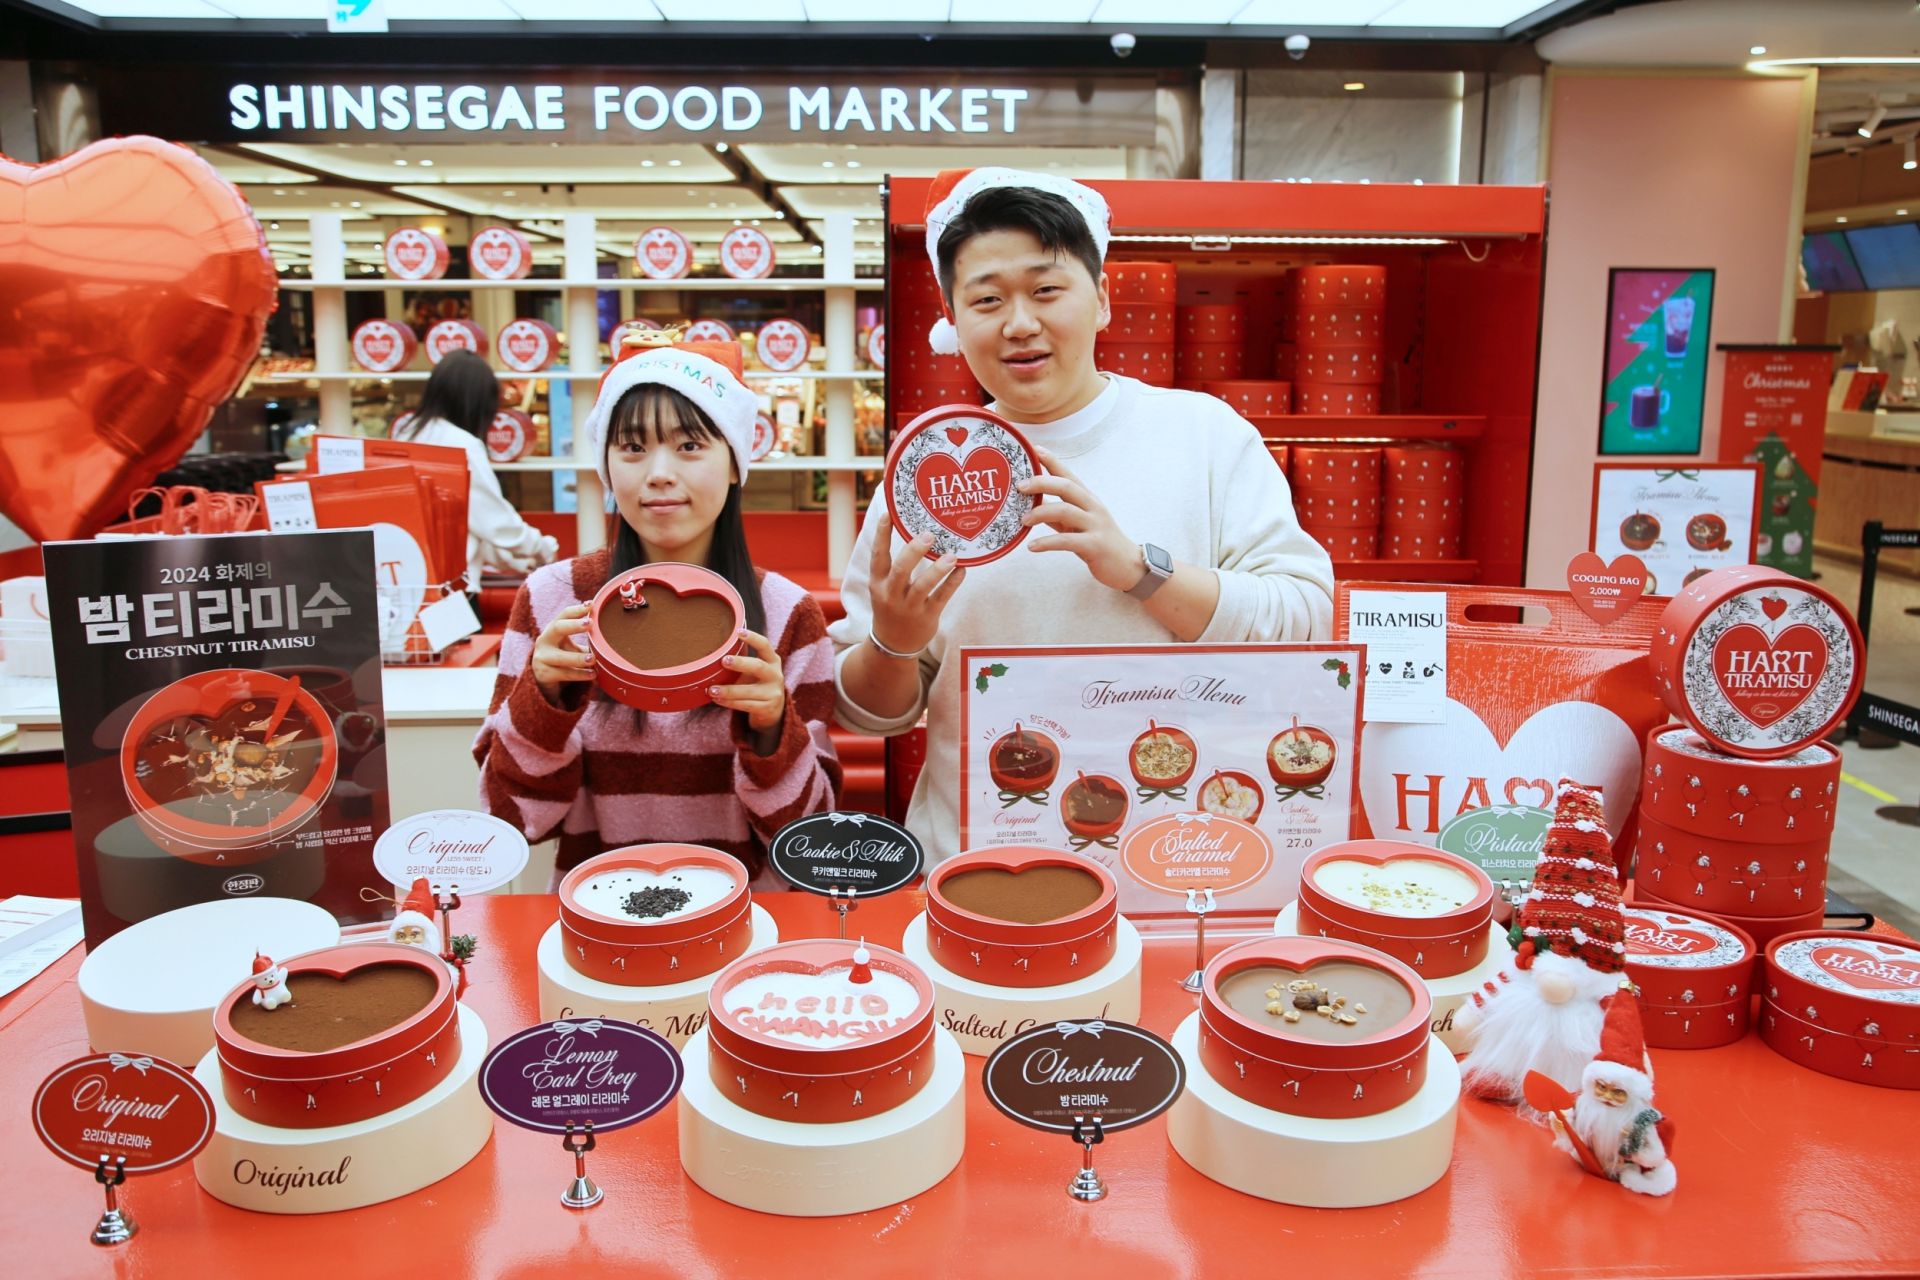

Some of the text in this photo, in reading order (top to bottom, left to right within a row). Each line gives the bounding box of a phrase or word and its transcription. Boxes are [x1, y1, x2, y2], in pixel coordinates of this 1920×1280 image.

[229, 84, 1029, 133] SHINSEGAE FOOD MARKET
[1744, 373, 1810, 389] Christmas
[928, 469, 998, 496] HART
[928, 488, 1002, 509] TIRAMISU
[160, 561, 273, 584] 2024 화제의
[1572, 574, 1640, 586] COOLING BAG
[78, 582, 352, 645] 밤 티라미수
[1353, 612, 1443, 628] TIRAMISU
[125, 636, 316, 660] CHESTNUT TIRAMISU
[1728, 650, 1813, 673] HART
[1082, 675, 1248, 709] Tiramisu Menu
[1723, 673, 1812, 689] TIRAMISU
[993, 810, 1041, 828] Original
[405, 827, 496, 864] Original
[786, 834, 907, 862] Cookie & Milk
[1150, 835, 1242, 864] Caramel
[1162, 828, 1229, 856] Salted
[1287, 838, 1313, 848] 27.0
[1464, 823, 1544, 856] Pistach
[406, 865, 435, 875] 오리지널
[436, 866, 465, 875] 티라미수
[811, 866, 878, 879] 쿠키앤밀크 티라미수
[1201, 867, 1230, 876] 티라미수
[1481, 859, 1517, 869] 피스타치오
[226, 878, 260, 891] 한정판
[758, 991, 889, 1016] hello
[940, 1008, 1007, 1039] Salted
[544, 1036, 619, 1066] Lemon
[522, 1061, 638, 1092] Earl Grey
[1022, 1047, 1144, 1085] Chestnut
[72, 1074, 180, 1128] Original
[531, 1092, 630, 1108] 레몬 얼그레이 티라미수
[1060, 1094, 1109, 1107] 밤 티라미수
[81, 1128, 153, 1149] 오리지널 티라미수
[234, 1155, 352, 1196] Original
